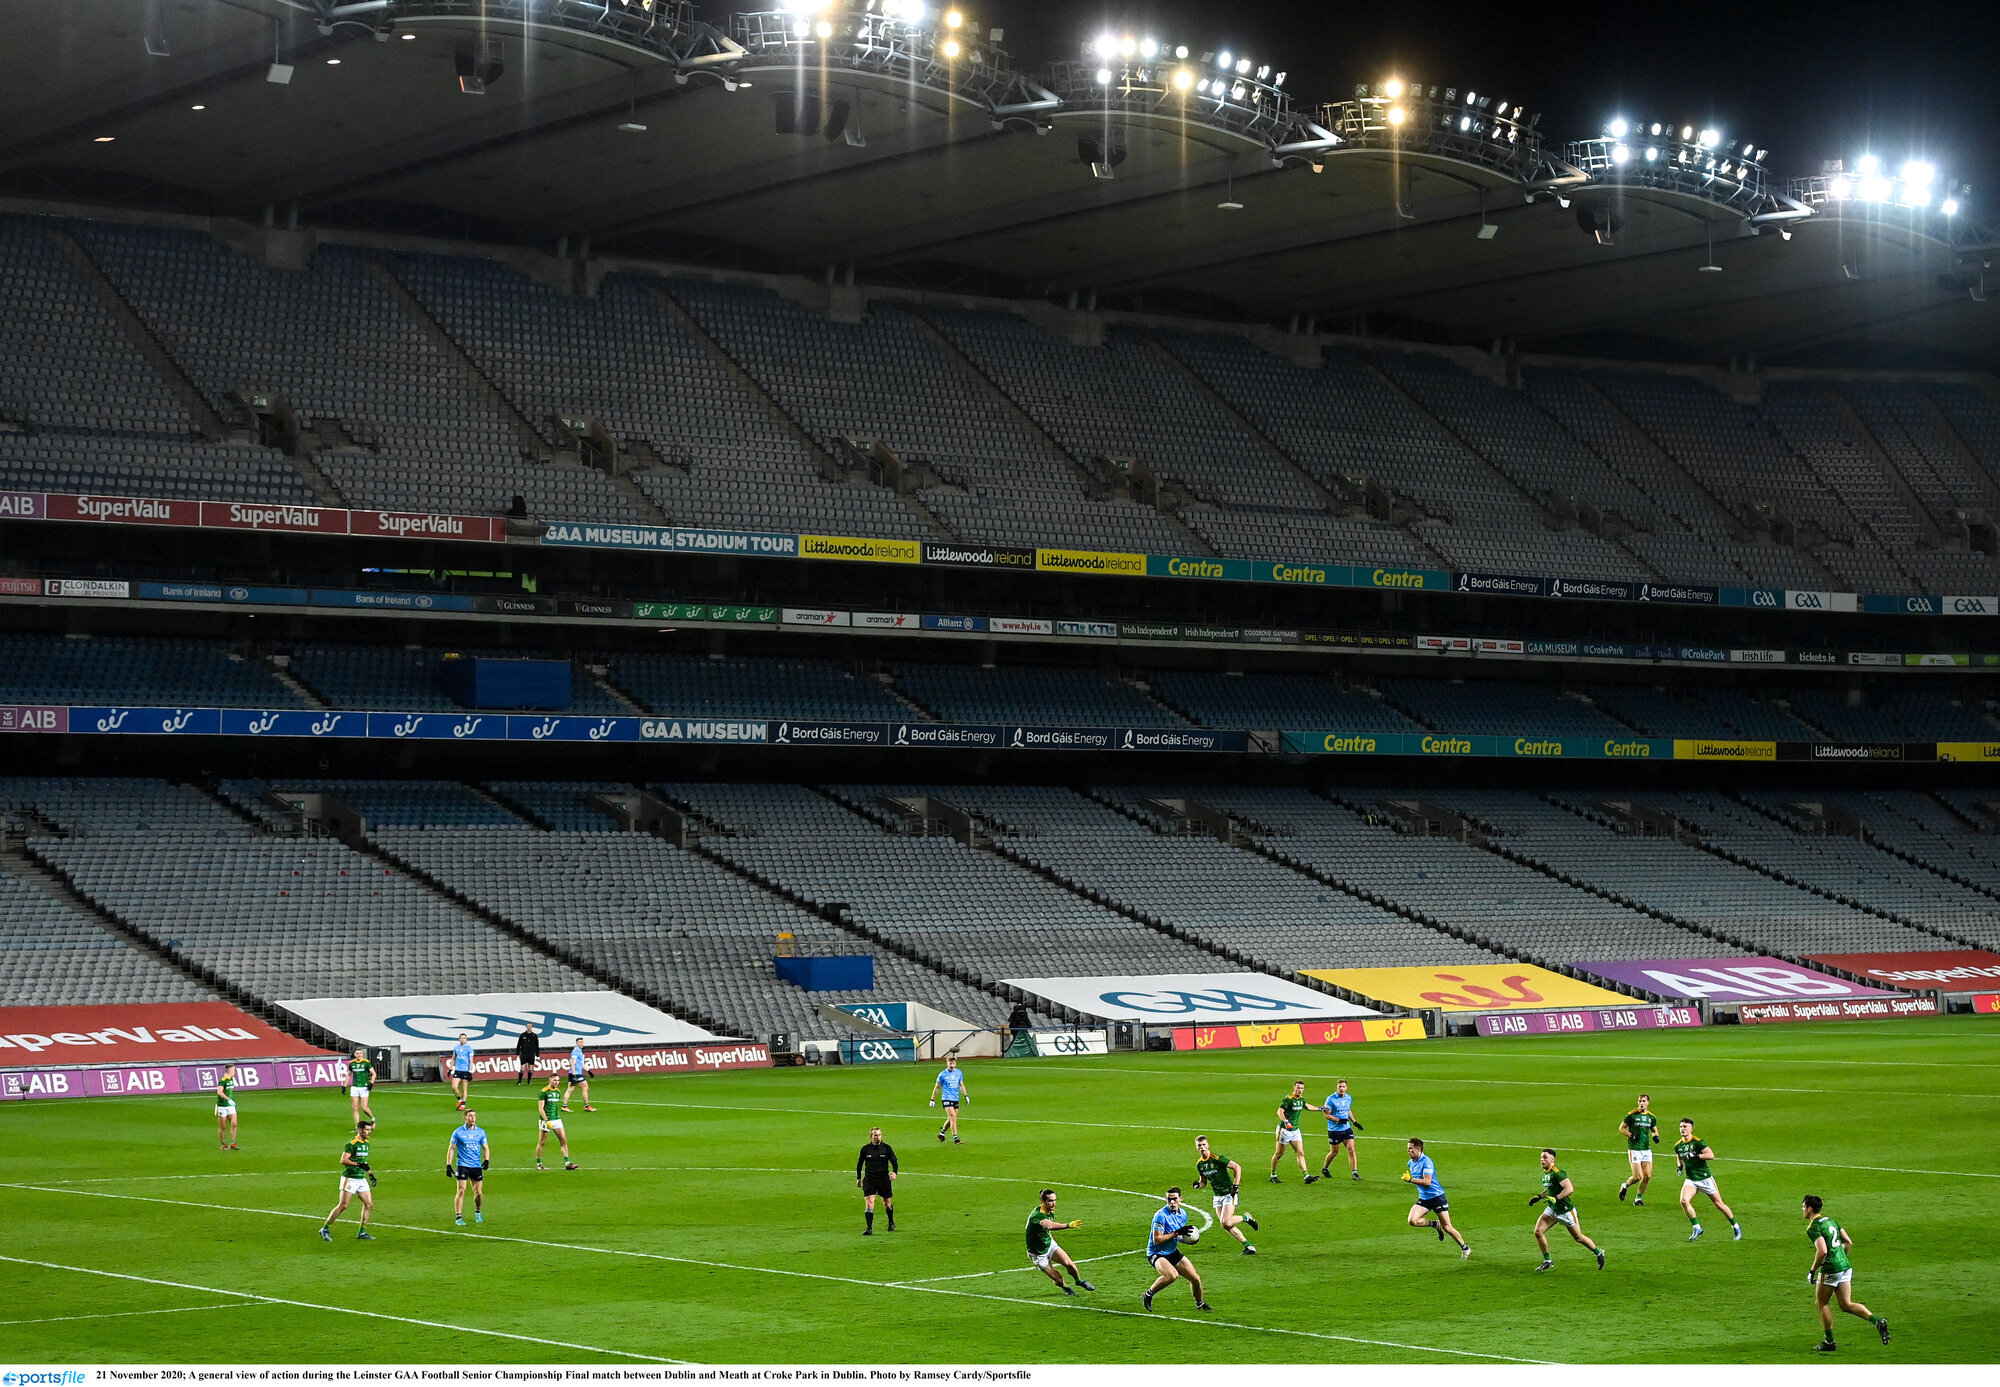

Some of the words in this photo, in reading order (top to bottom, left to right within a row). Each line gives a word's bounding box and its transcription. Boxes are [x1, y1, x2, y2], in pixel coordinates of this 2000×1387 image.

[0, 497, 34, 515] AIB
[77, 496, 170, 520] SuperValu
[230, 505, 319, 528] SuperValu
[379, 513, 463, 535] SuperValu
[545, 526, 583, 541] GAA
[586, 528, 657, 546] MUSEUM
[660, 534, 673, 546] &
[676, 533, 748, 550] STADIUM
[750, 537, 794, 552] TOUR
[1168, 558, 1224, 578] Centra
[1272, 564, 1326, 583] Centra
[64, 581, 125, 591] CLONDALKIN
[1373, 569, 1424, 588] Centra
[1471, 577, 1491, 589] Bord
[1492, 578, 1510, 590] Gáis
[1510, 580, 1538, 593] Energy
[163, 587, 183, 596] Bank
[184, 588, 193, 596] of
[194, 588, 221, 597] Ireland
[1563, 583, 1582, 594] Bord
[1583, 583, 1600, 595] Gáis
[1601, 586, 1628, 598] Energy
[1651, 588, 1669, 599] Bord
[1670, 588, 1687, 600] Gáis
[1687, 590, 1713, 602] Energy
[1753, 590, 1777, 607] GAA
[355, 595, 375, 604] Bank
[376, 596, 384, 604] of
[385, 596, 410, 606] Ireland
[503, 602, 535, 610] GUINNESS
[581, 604, 612, 613] GUINNESS
[1795, 593, 1823, 609] GAA
[1906, 597, 1933, 613] GAA
[1954, 598, 1986, 613] GAA
[686, 606, 702, 618] eir
[712, 607, 728, 619] eir
[736, 608, 751, 620] eir
[759, 609, 774, 621] eir
[796, 613, 825, 621] aramark
[866, 616, 894, 624] aramark
[938, 618, 962, 628] Allianz
[1002, 620, 1041, 632] www.hyl.ie
[1122, 626, 1136, 635] Irish
[1137, 627, 1173, 637] Independent
[1185, 628, 1198, 637] Irish
[1200, 629, 1235, 639] Independent
[1244, 630, 1271, 638] COSGROVE
[1528, 643, 1544, 653] GAA
[1545, 644, 1577, 654] MUSEUM
[1583, 645, 1624, 655] @CrokePark
[1681, 648, 1725, 660] @CrokePark
[1742, 651, 1758, 661] Irish
[1759, 651, 1773, 661] Life
[1799, 652, 1836, 662] tickets.ie
[21, 710, 56, 728] AIB
[97, 709, 128, 732] eir
[162, 710, 193, 732] eir
[249, 711, 279, 733] eir
[312, 713, 341, 734] eir
[394, 714, 422, 736] eir
[453, 716, 481, 737] eir
[532, 717, 559, 739] eir
[589, 718, 616, 739] eir
[641, 722, 683, 739] GAA
[687, 723, 767, 740] MUSEUM
[792, 727, 818, 739] Bord
[820, 727, 842, 740] Gáis
[843, 728, 880, 742] Energy
[911, 729, 936, 741] Bord
[938, 729, 959, 742] Gáis
[961, 731, 996, 744] Energy
[1026, 731, 1050, 743] Bord
[1051, 731, 1073, 744] Gáis
[1074, 733, 1107, 746] Energy
[1136, 733, 1159, 745] Bord
[1160, 733, 1181, 746] Gáis
[1182, 735, 1214, 748] Energy
[1324, 734, 1376, 752] Centra
[1421, 736, 1471, 754] Centra
[1514, 738, 1562, 756] Centra
[1604, 740, 1650, 757] Centra
[1419, 973, 1544, 1008] eir
[1641, 966, 1852, 998] AIB
[1099, 989, 1323, 1013] GAA
[1891, 998, 1935, 1018] SuperValu
[1616, 1011, 1638, 1026] AIB
[1669, 1009, 1692, 1024] AIB
[1793, 1004, 1840, 1020] SuperValu
[1843, 1000, 1889, 1020] SuperValu
[383, 1011, 655, 1042] GAA
[1385, 1020, 1402, 1038] eir
[1504, 1017, 1528, 1032] AIB
[1561, 1014, 1584, 1030] AIB
[1195, 1028, 1216, 1048] eir
[1261, 1026, 1280, 1045] eir
[1323, 1022, 1343, 1041] eir
[776, 1035, 784, 1047] 5
[1053, 1036, 1090, 1053] GAA
[376, 1051, 383, 1061] 4
[694, 1043, 766, 1068] SuperValu
[859, 1042, 899, 1060] GAA
[614, 1050, 688, 1075] SuperValu
[29, 1073, 69, 1094] AIB
[126, 1070, 166, 1093] AIB
[1828, 1225, 1840, 1248] 2
